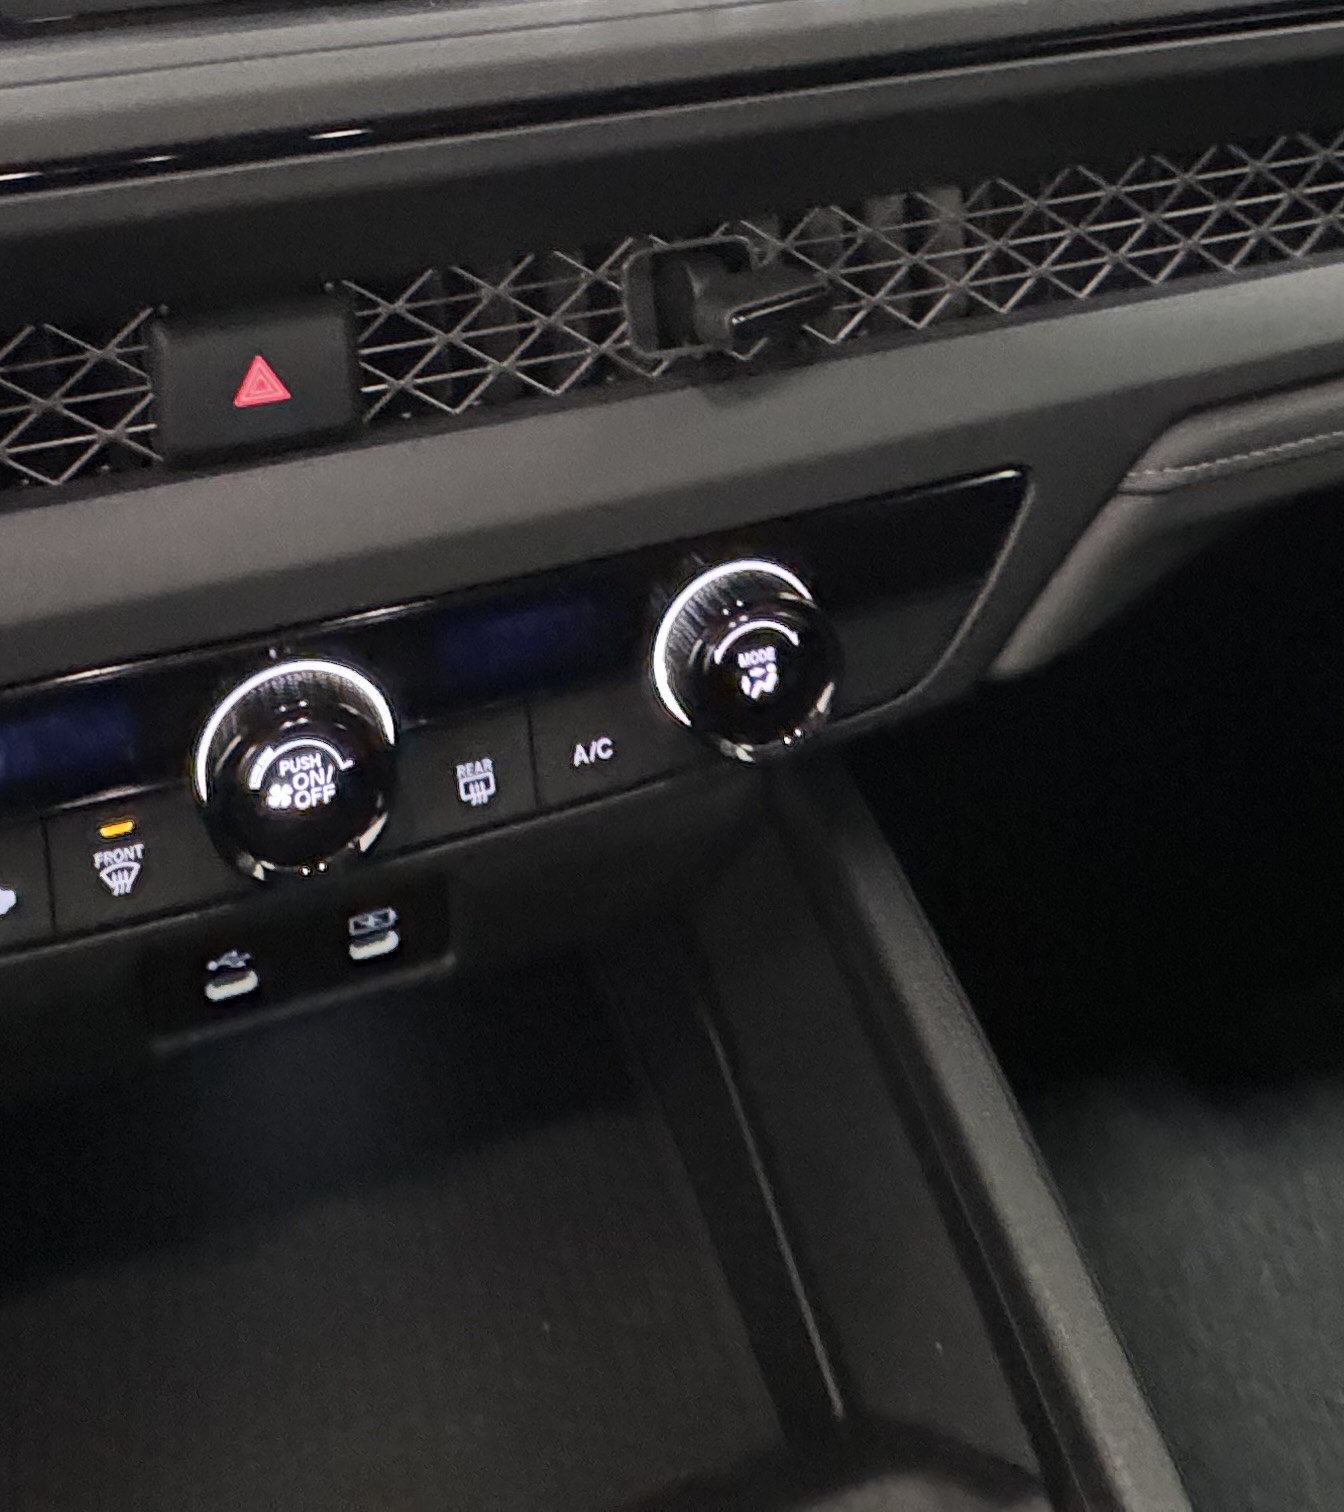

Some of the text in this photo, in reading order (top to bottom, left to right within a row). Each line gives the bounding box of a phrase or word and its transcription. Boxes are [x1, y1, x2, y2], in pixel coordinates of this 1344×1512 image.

[737, 645, 778, 668] MODE
[278, 752, 323, 776] PUSH
[573, 737, 614, 767] A/C
[456, 758, 494, 778] REAR
[294, 784, 337, 810] OFF
[93, 843, 144, 868] FRONT
